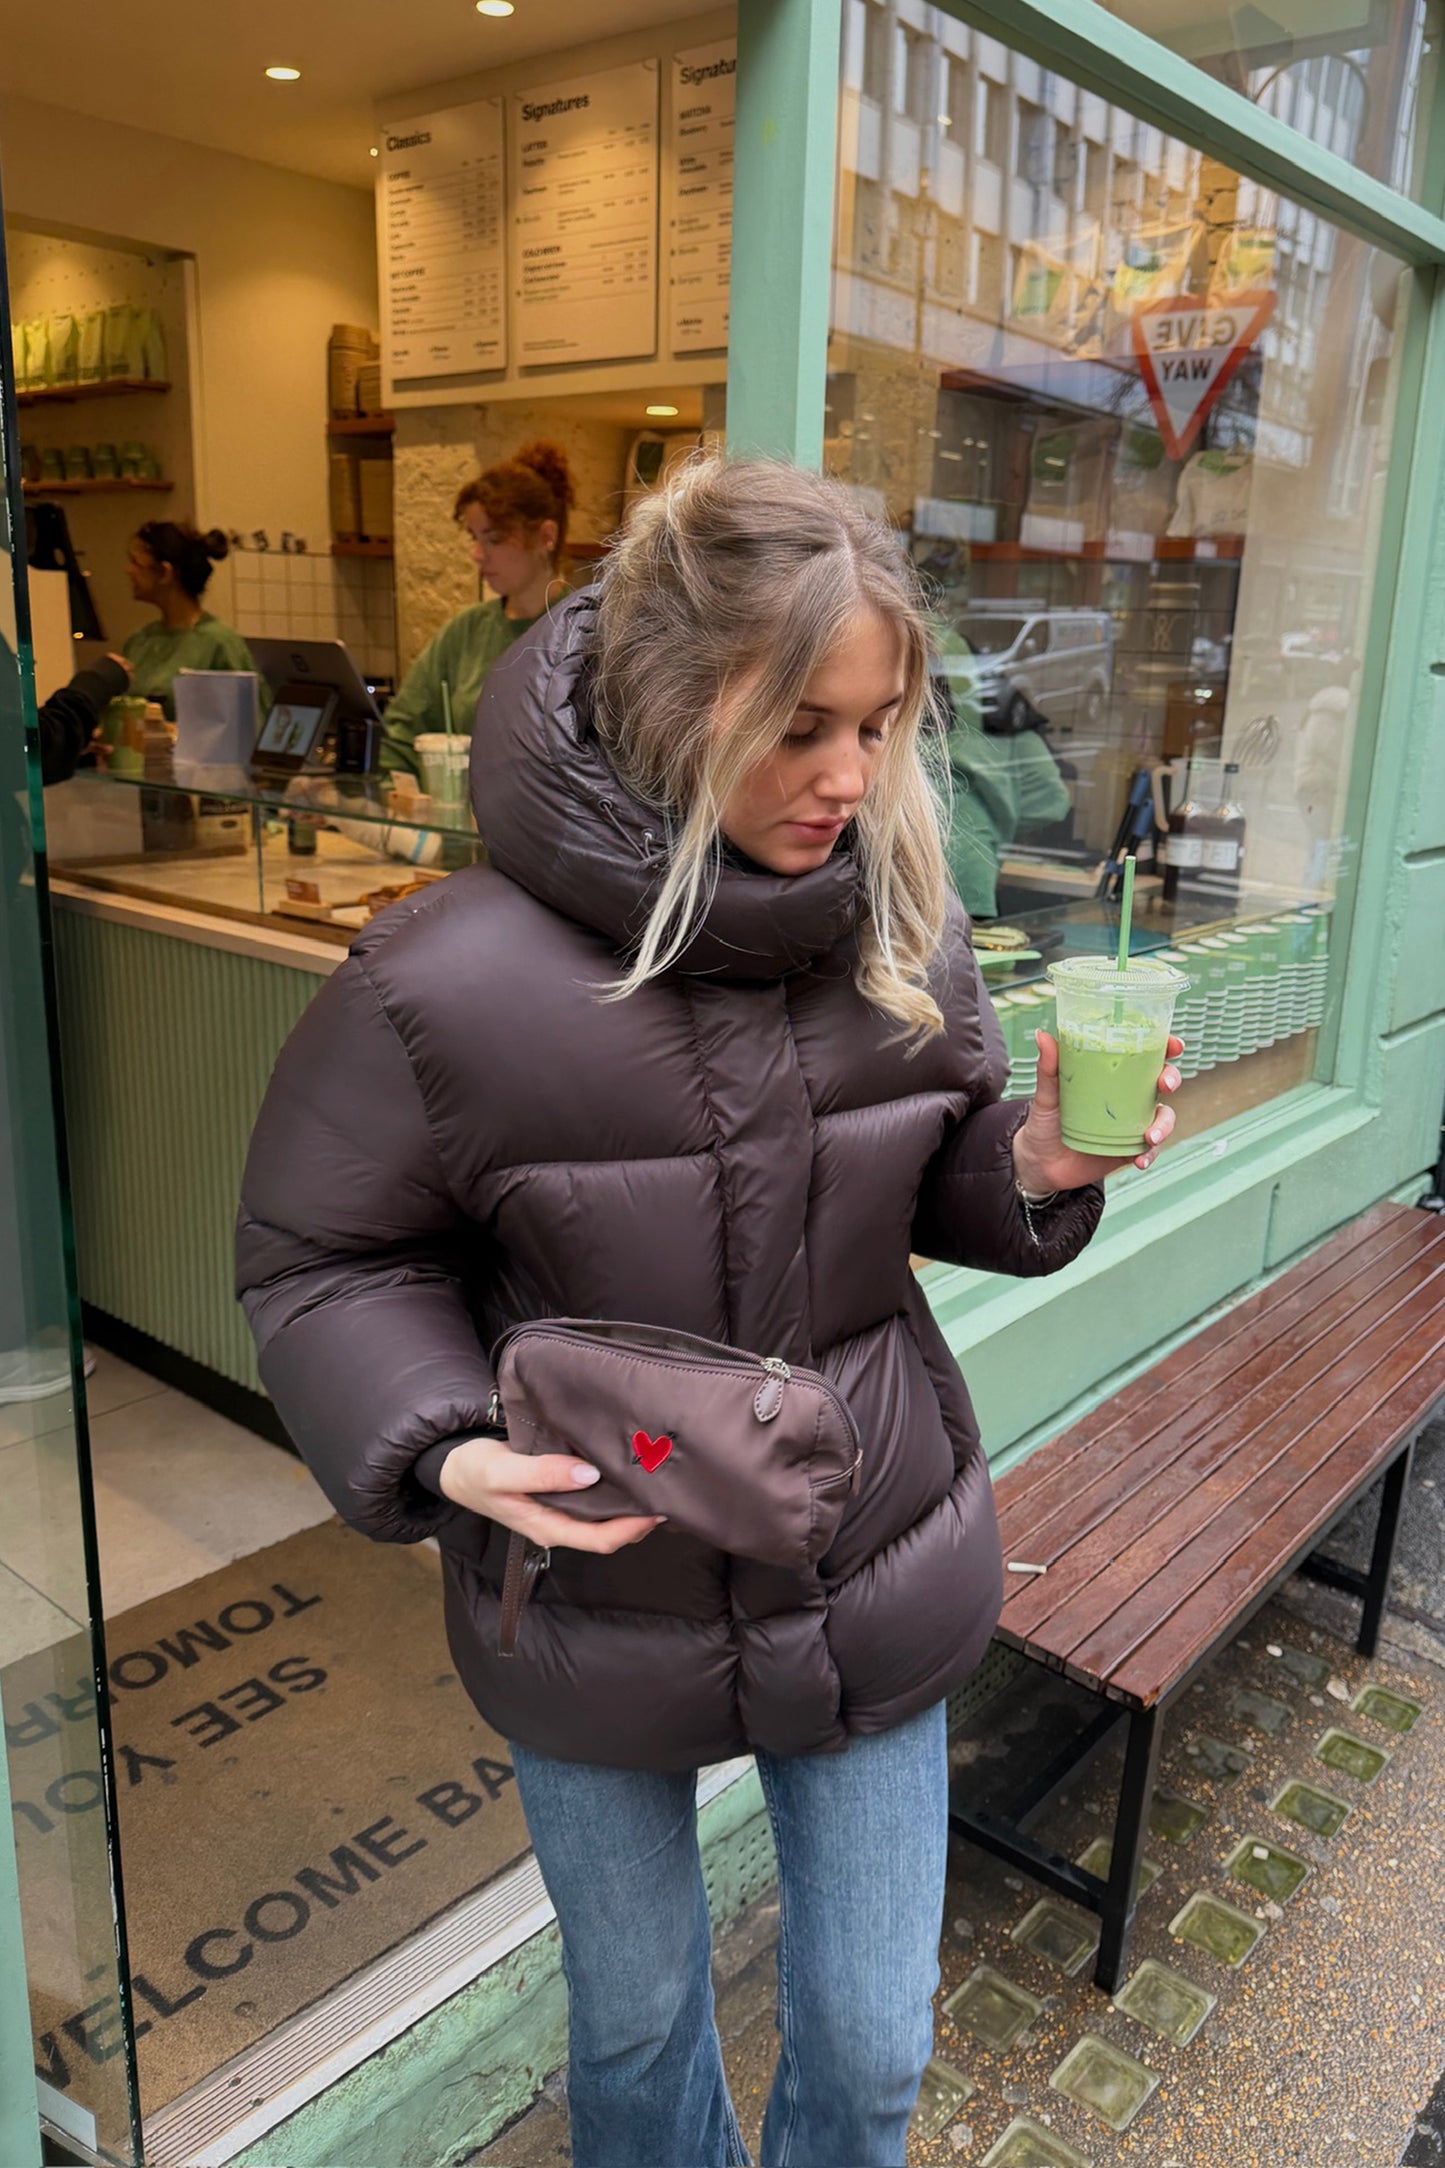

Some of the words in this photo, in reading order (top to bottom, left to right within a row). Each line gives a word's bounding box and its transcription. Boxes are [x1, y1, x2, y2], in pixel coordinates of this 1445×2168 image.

[680, 58, 736, 86] Signatu
[521, 94, 590, 122] Signatures
[5, 1583, 323, 1748] TOMORR
[169, 1656, 327, 1749] SEE
[415, 1757, 515, 1828] BA
